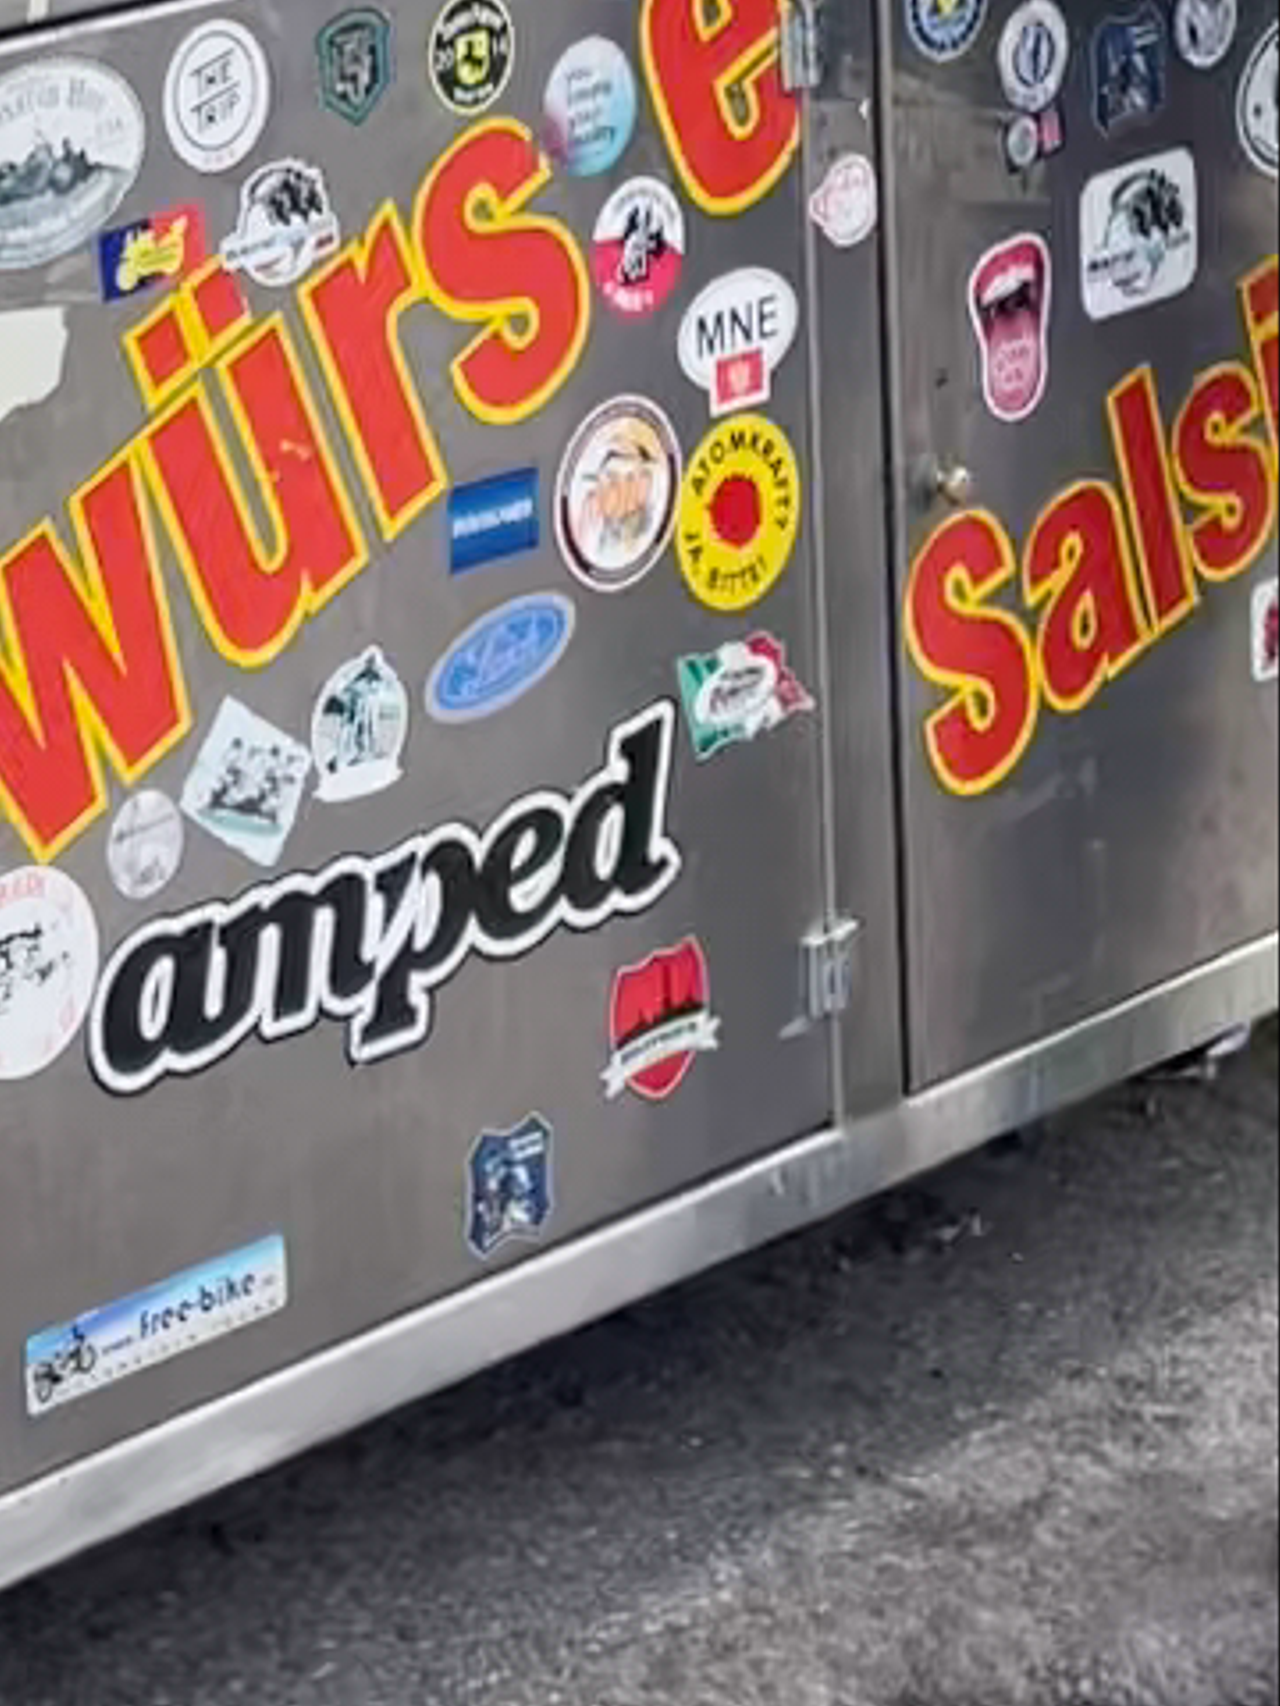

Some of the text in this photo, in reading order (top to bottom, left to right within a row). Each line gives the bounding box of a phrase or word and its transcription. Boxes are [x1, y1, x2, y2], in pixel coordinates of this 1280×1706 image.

[191, 95, 241, 132] TRIP
[695, 295, 779, 359] MNE
[88, 698, 682, 1097] amped
[140, 1273, 256, 1339] free-bike
